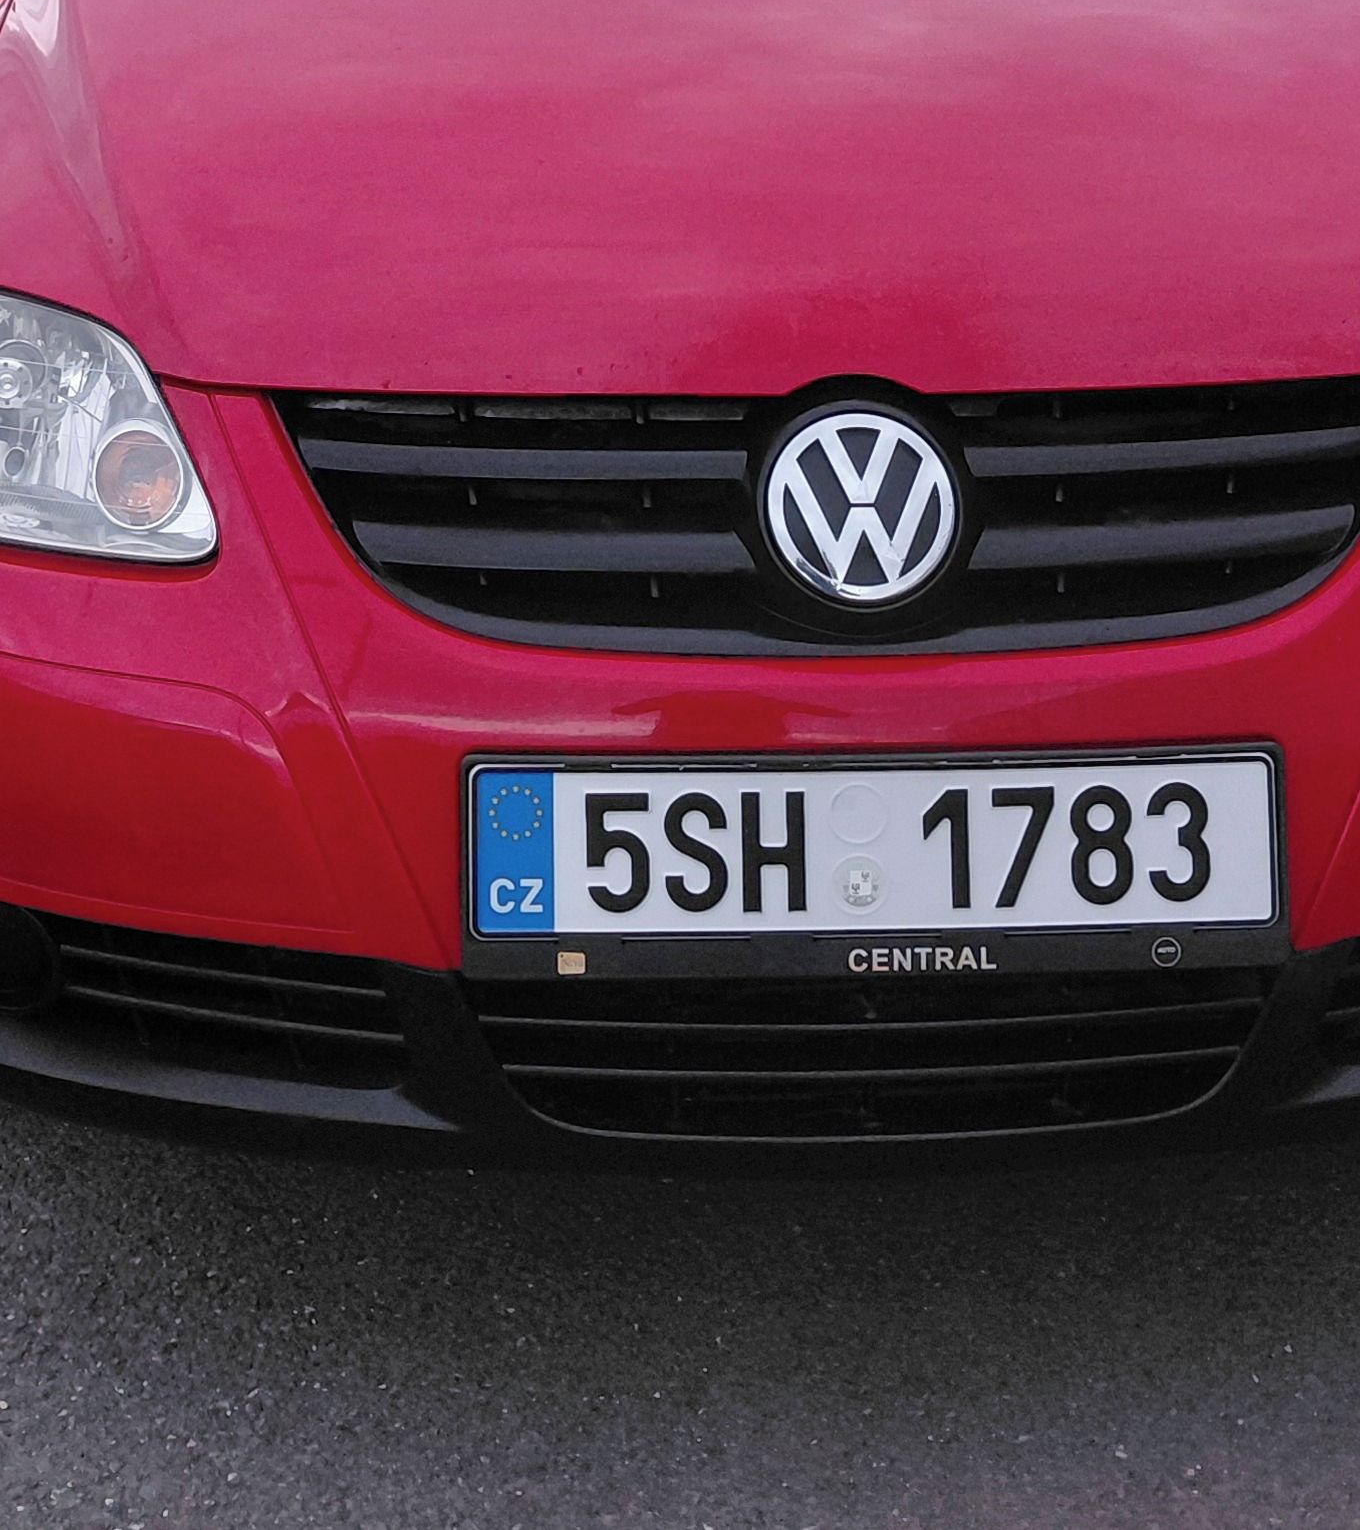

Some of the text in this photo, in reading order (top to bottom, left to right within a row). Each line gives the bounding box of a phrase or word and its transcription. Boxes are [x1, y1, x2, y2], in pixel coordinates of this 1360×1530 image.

[490, 781, 1211, 913] CZ 5SH 1783
[848, 946, 997, 972] CENTRAL
